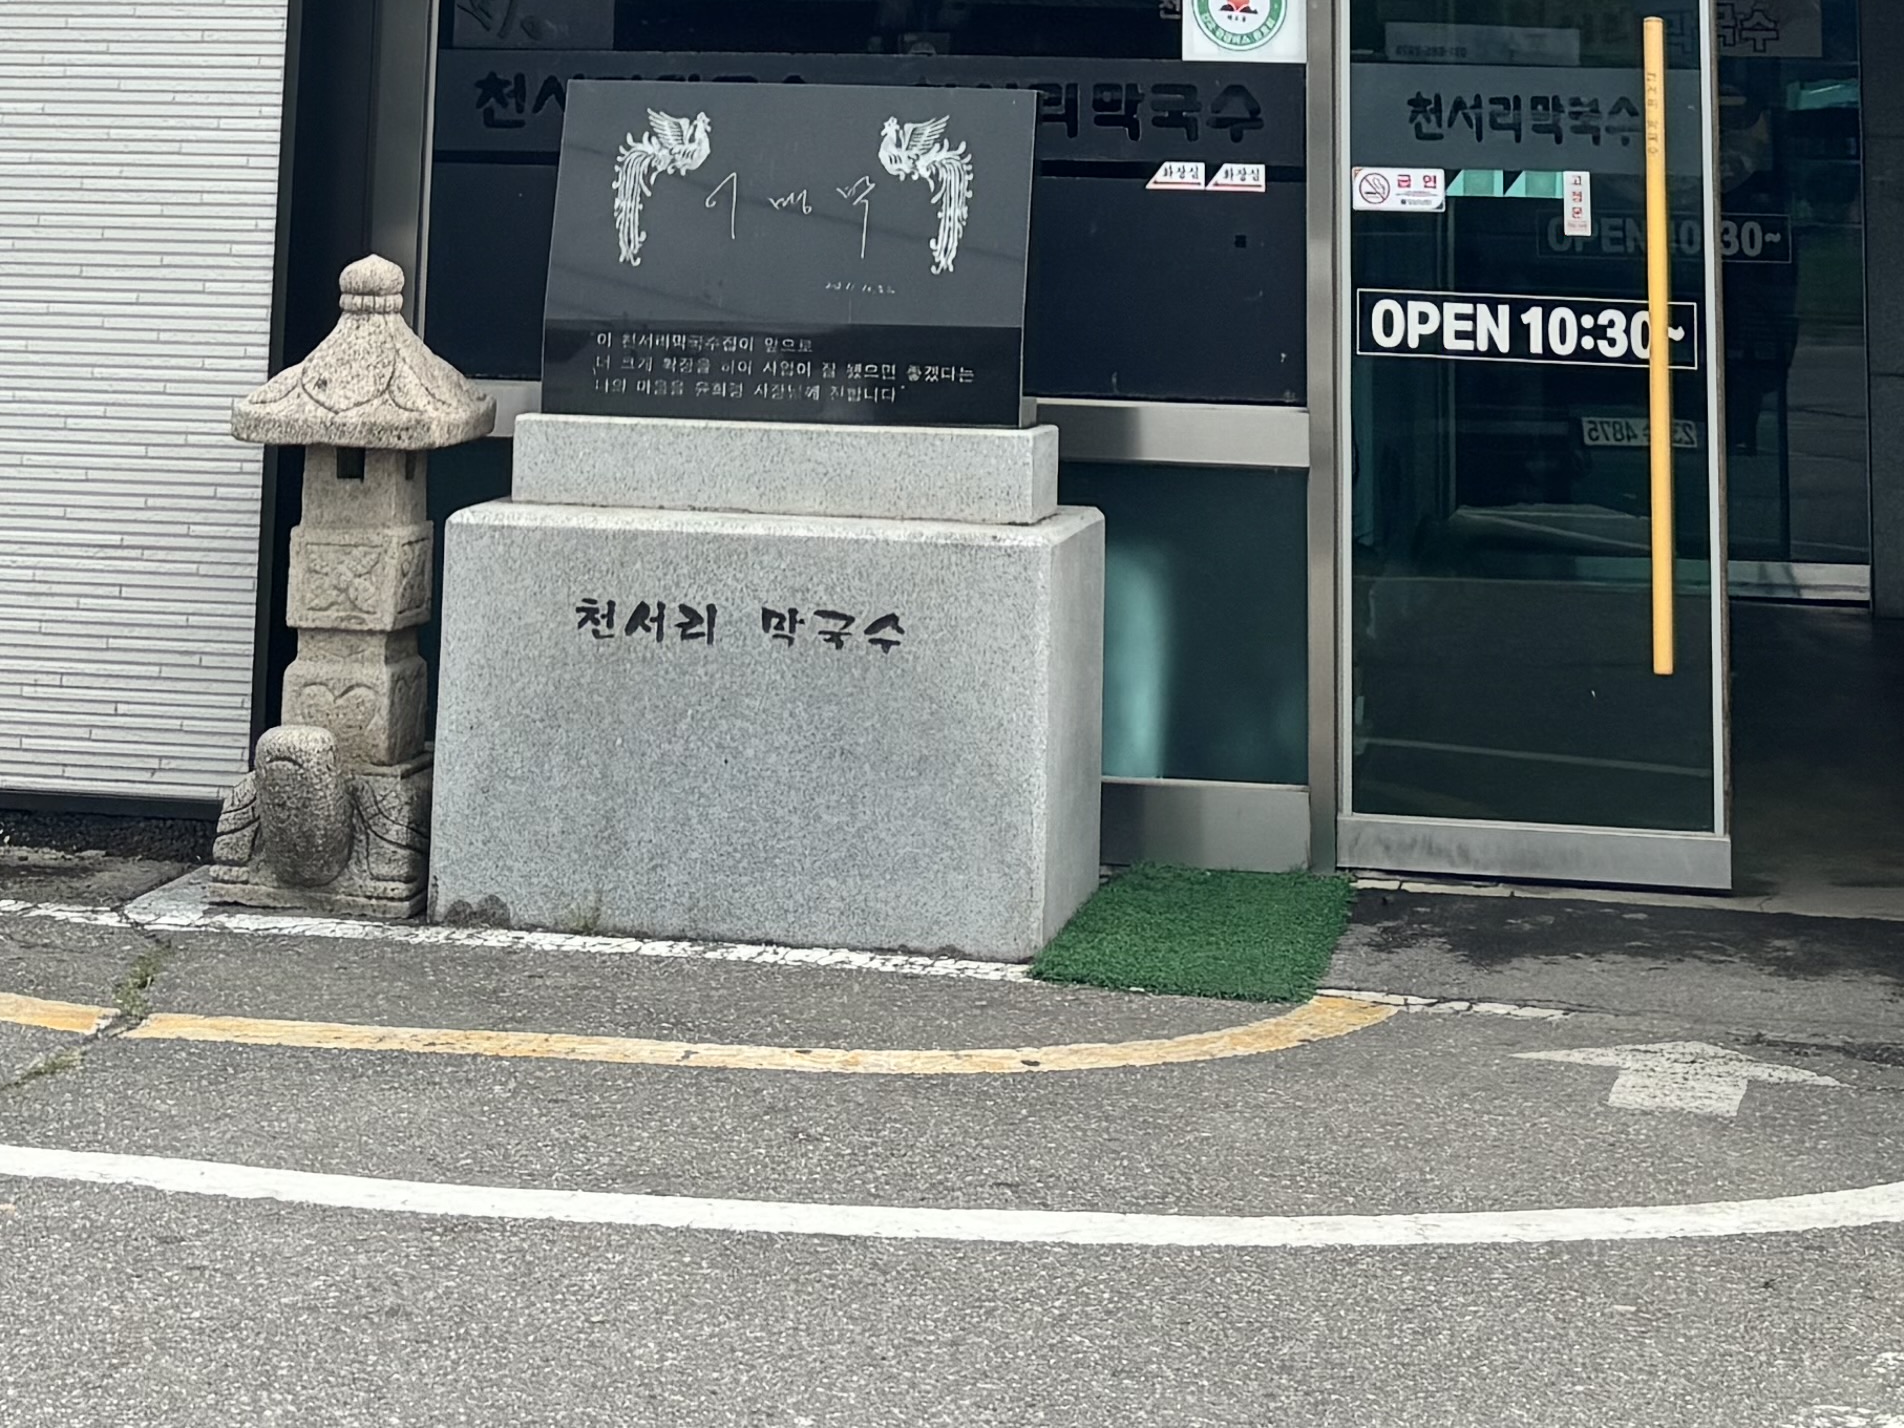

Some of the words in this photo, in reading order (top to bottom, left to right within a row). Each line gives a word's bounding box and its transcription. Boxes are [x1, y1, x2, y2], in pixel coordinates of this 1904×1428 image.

[1162, 165, 1200, 180] 화장실
[1223, 166, 1261, 182] 화장실
[1371, 299, 1510, 353] OPEN
[1521, 306, 1685, 359] 10:30~
[575, 597, 718, 644] 천서리
[761, 606, 906, 653] 막국수
